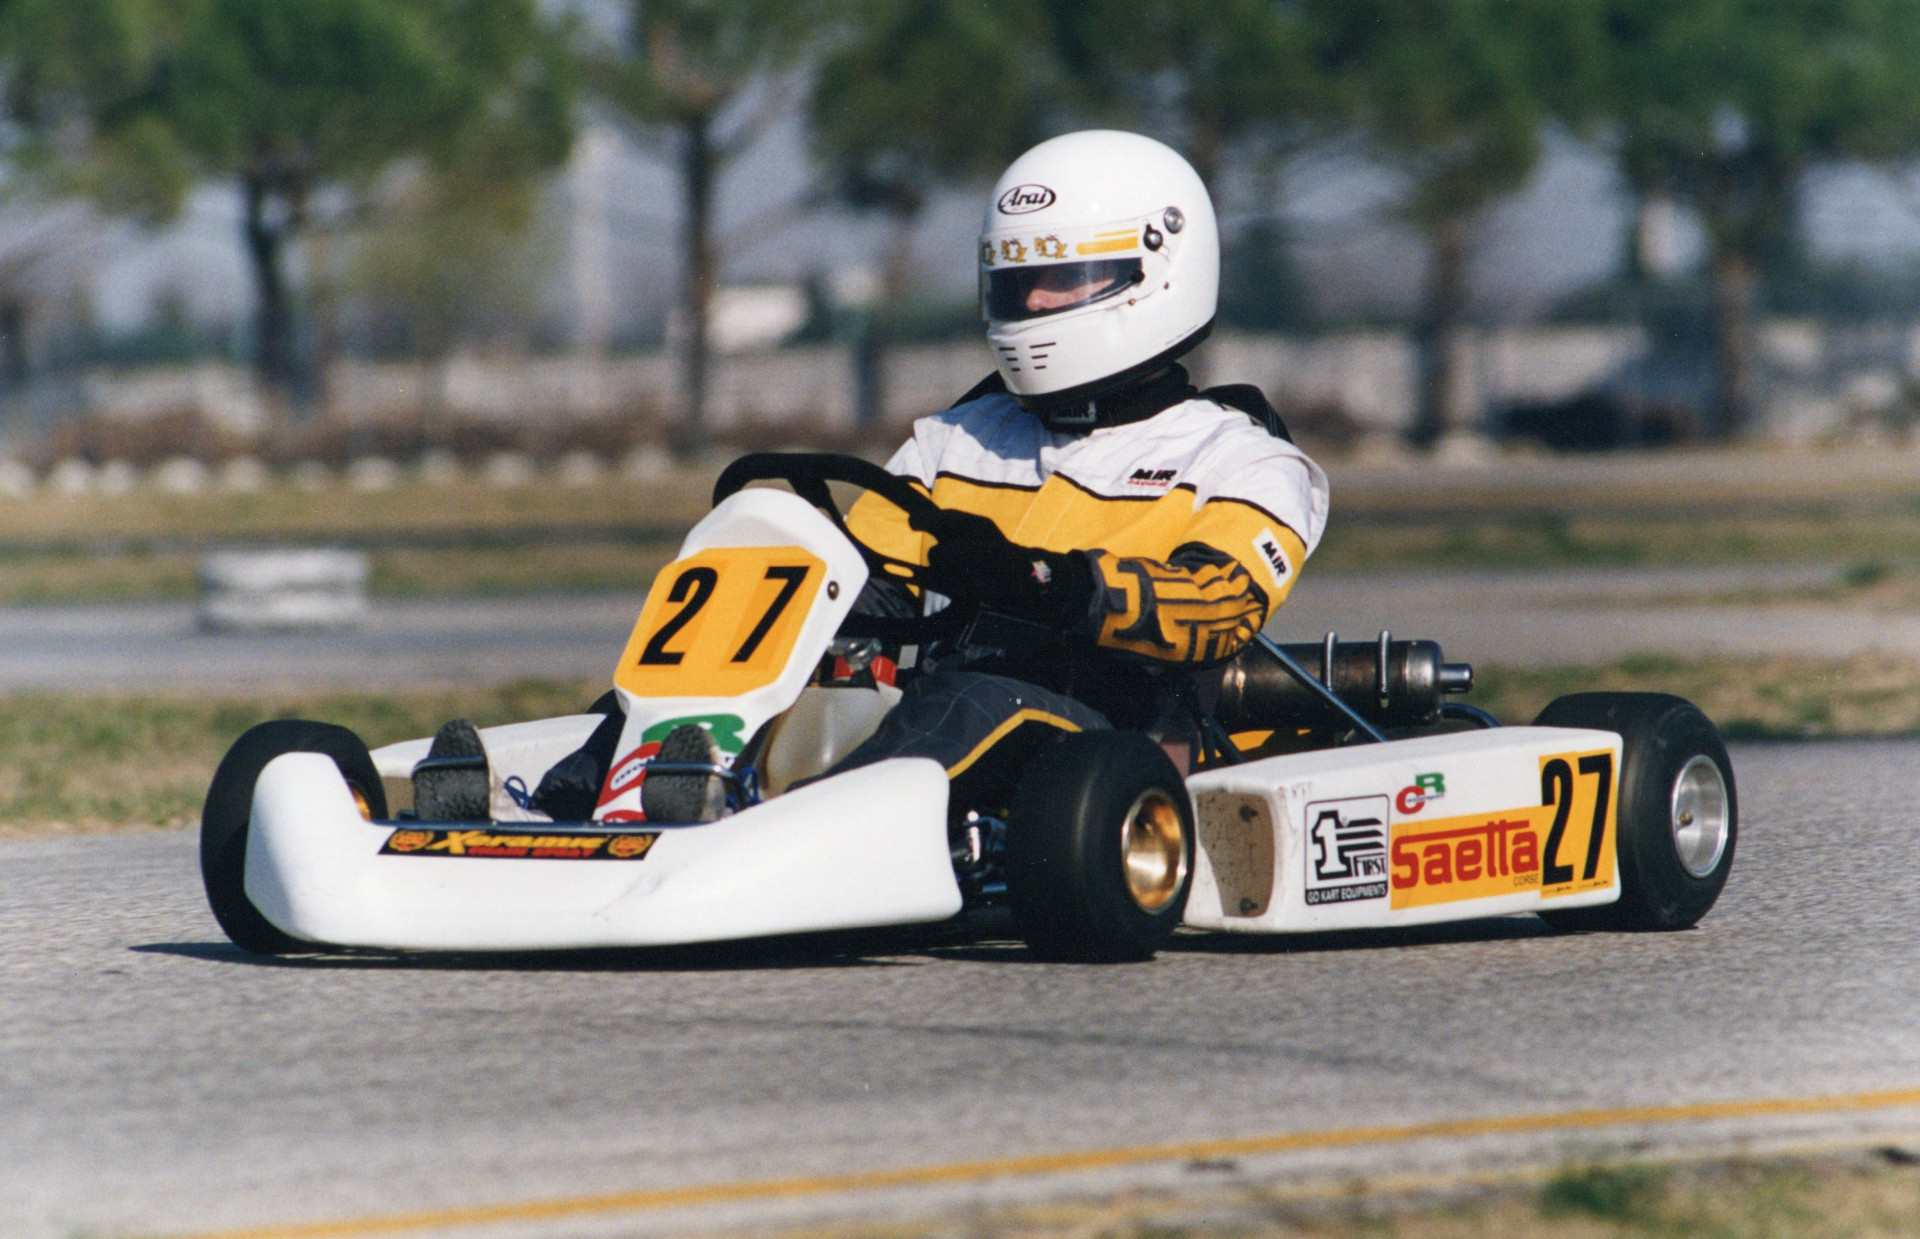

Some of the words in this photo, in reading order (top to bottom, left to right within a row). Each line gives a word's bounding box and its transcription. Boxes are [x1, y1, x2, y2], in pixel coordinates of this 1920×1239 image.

[1000, 187, 1048, 208] Arai
[637, 566, 811, 666] 27
[1541, 752, 1612, 886] 27
[1392, 820, 1539, 889] Saetta
[1307, 890, 1321, 903] GO
[1321, 887, 1341, 902] KART
[1341, 882, 1387, 900] EQUIPMENTS
[1513, 873, 1539, 887] CORSE
